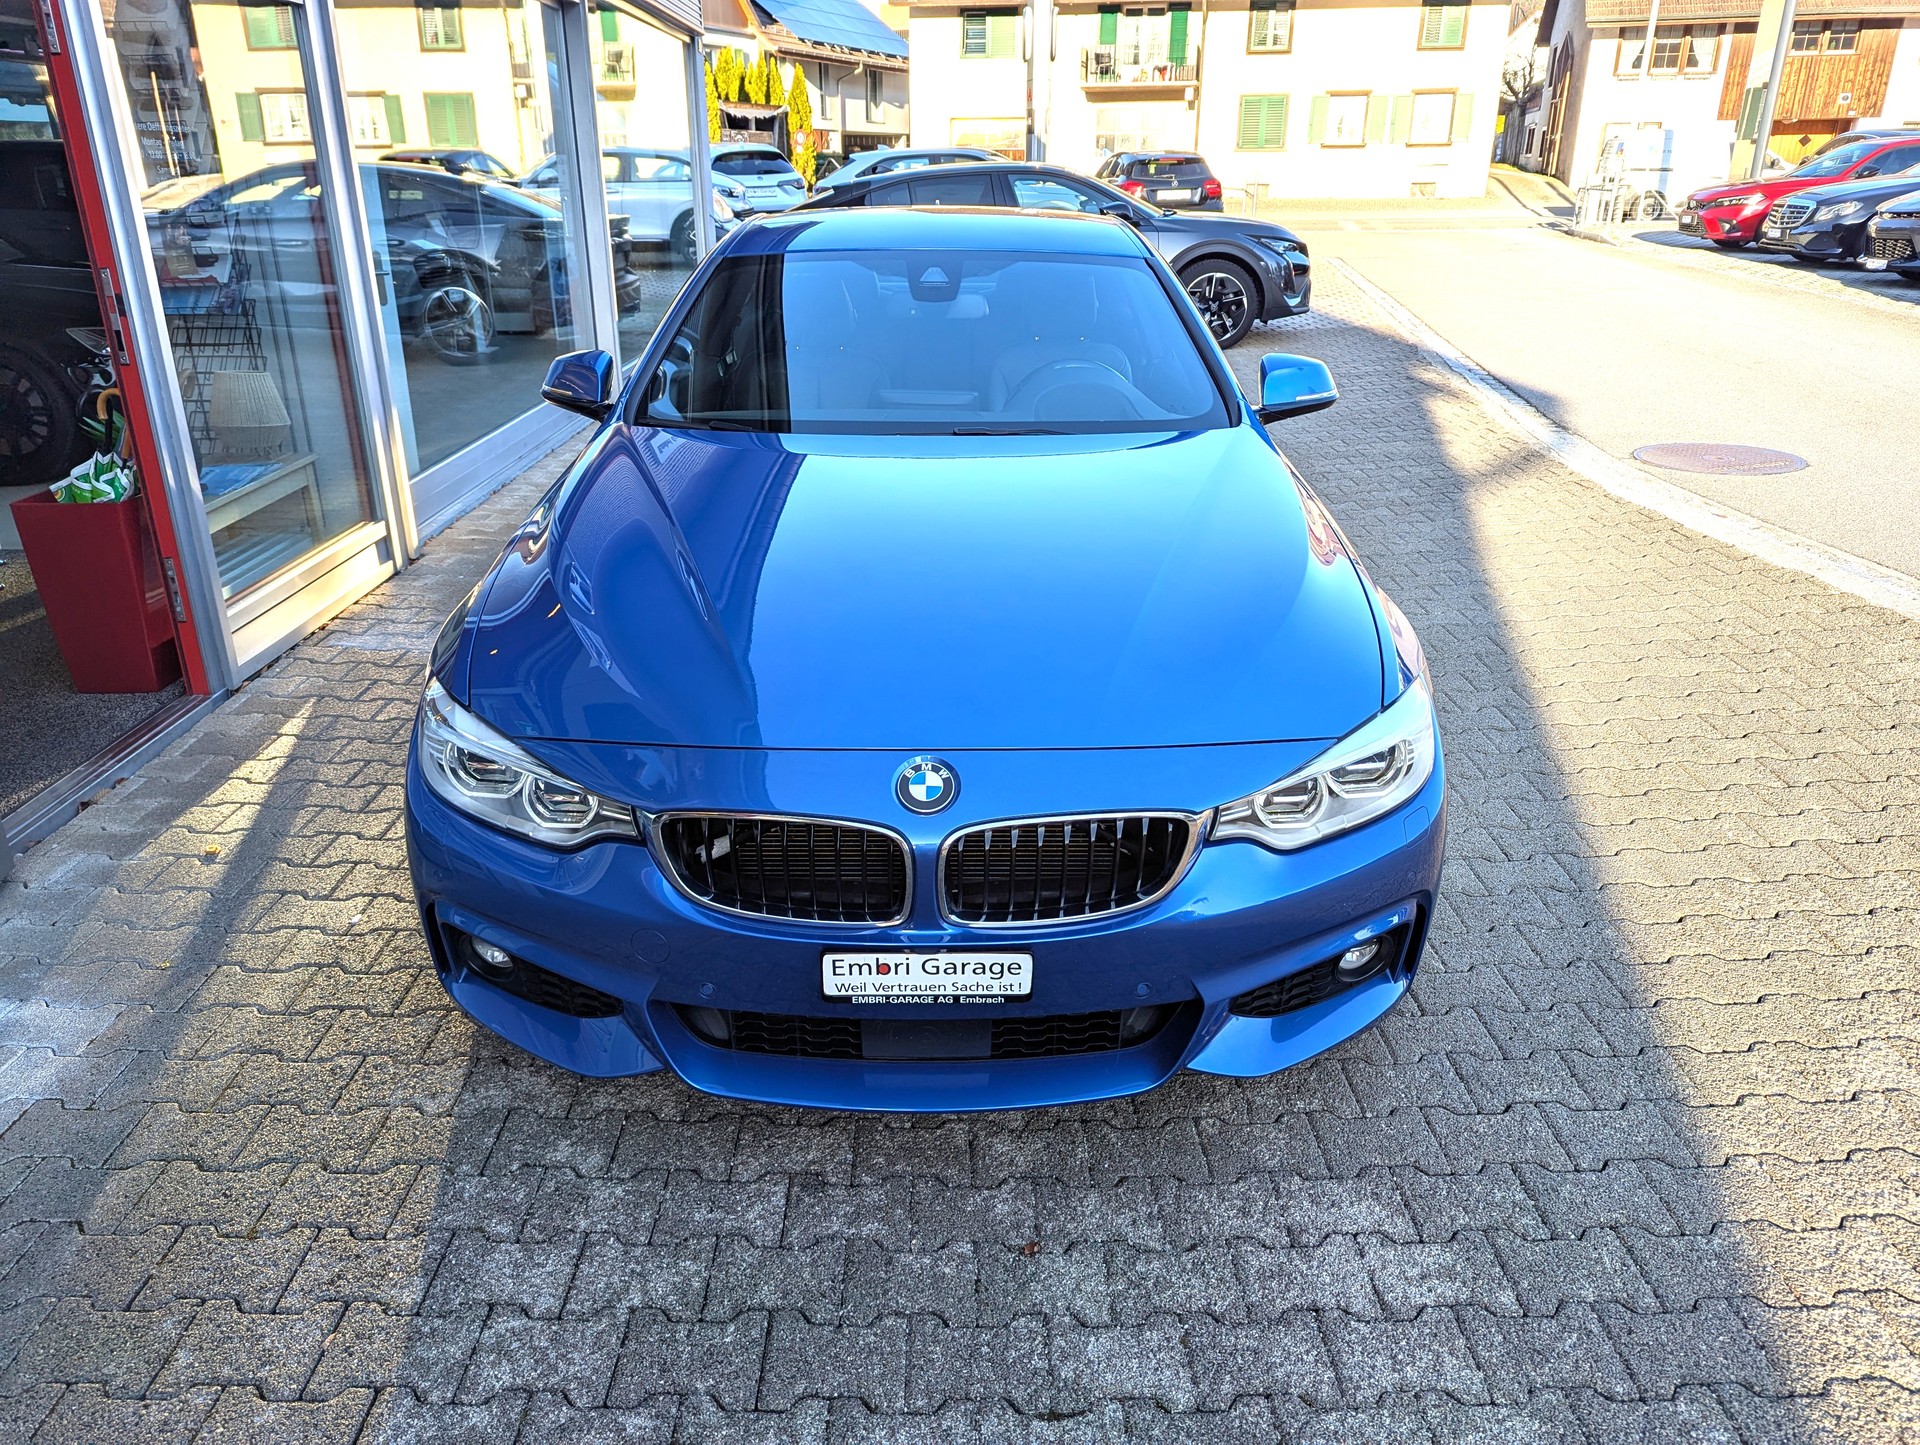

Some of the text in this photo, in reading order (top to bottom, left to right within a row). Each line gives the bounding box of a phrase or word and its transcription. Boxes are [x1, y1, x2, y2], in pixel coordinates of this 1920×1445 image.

[141, 137, 162, 148] Montag
[904, 763, 950, 779] BMW
[831, 957, 1022, 979] Embri Garage
[834, 982, 867, 993] Weil
[872, 982, 947, 993] Vertrauen
[951, 981, 994, 992] Sache
[852, 996, 1004, 1004] EMBRI-GARAGE AG Embrach
